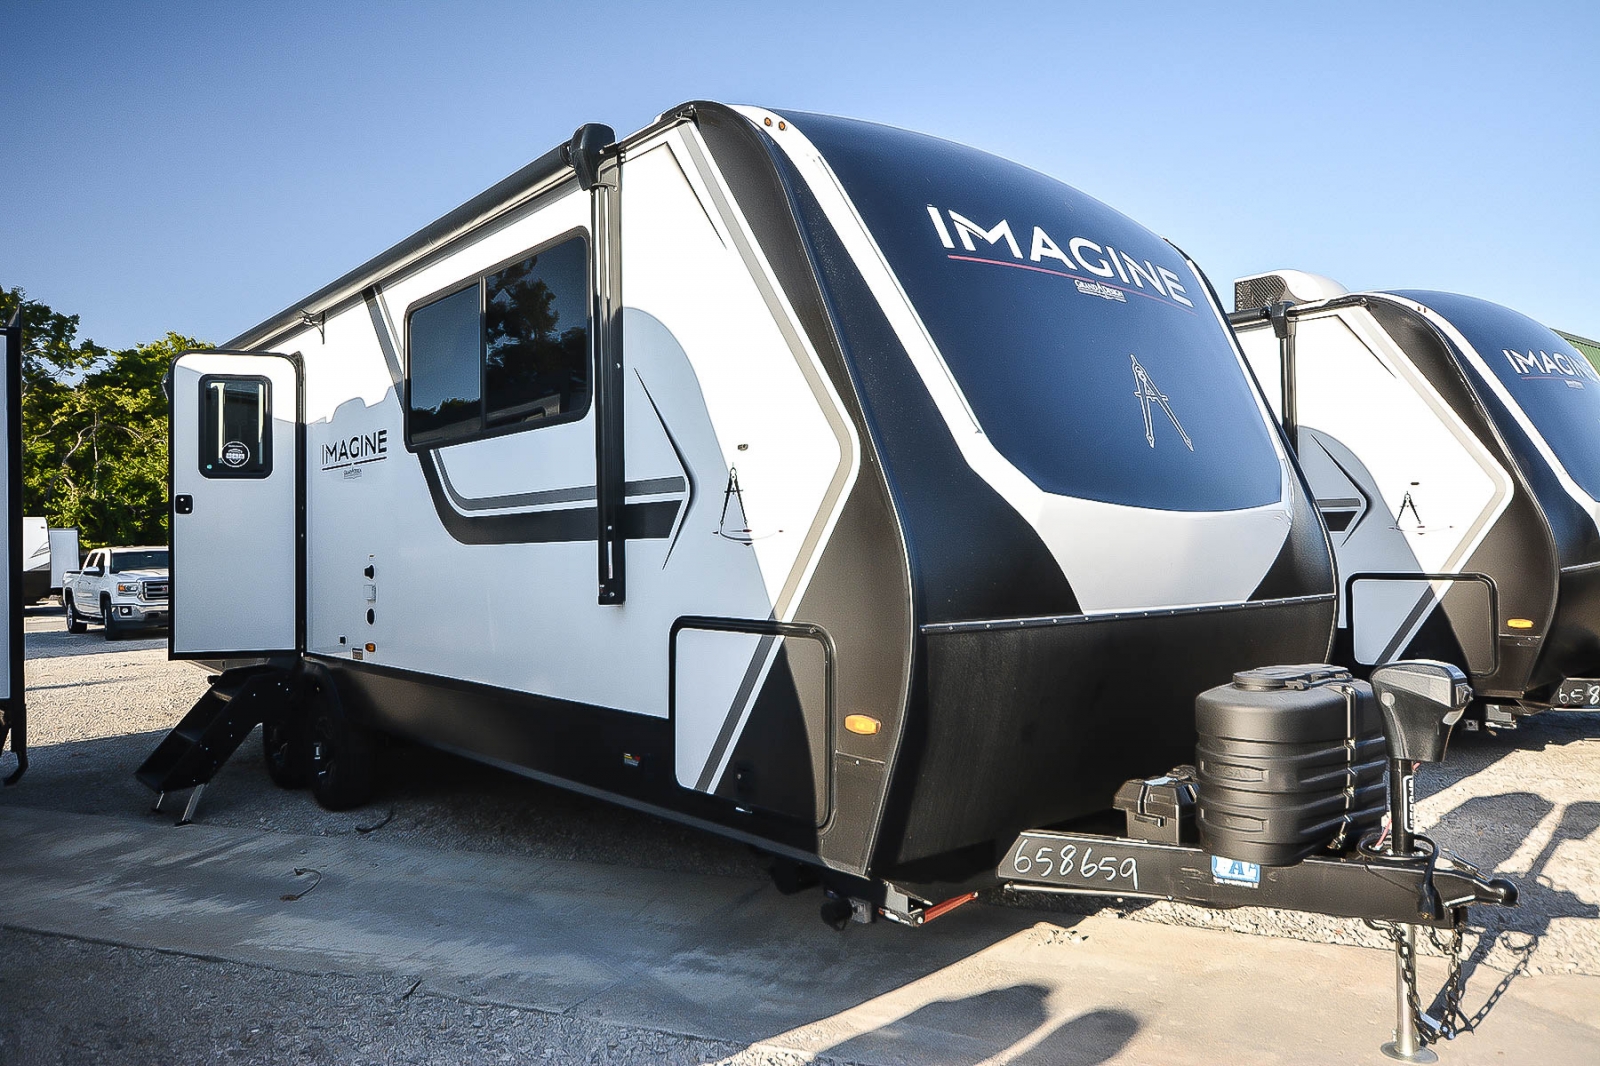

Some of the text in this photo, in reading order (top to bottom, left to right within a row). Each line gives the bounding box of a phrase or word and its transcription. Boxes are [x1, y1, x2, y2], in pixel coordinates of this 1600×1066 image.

[926, 204, 1194, 308] IMAGINE
[321, 429, 387, 465] IMAGINE
[1558, 684, 1600, 705] 658
[1013, 838, 1138, 890] 658659
